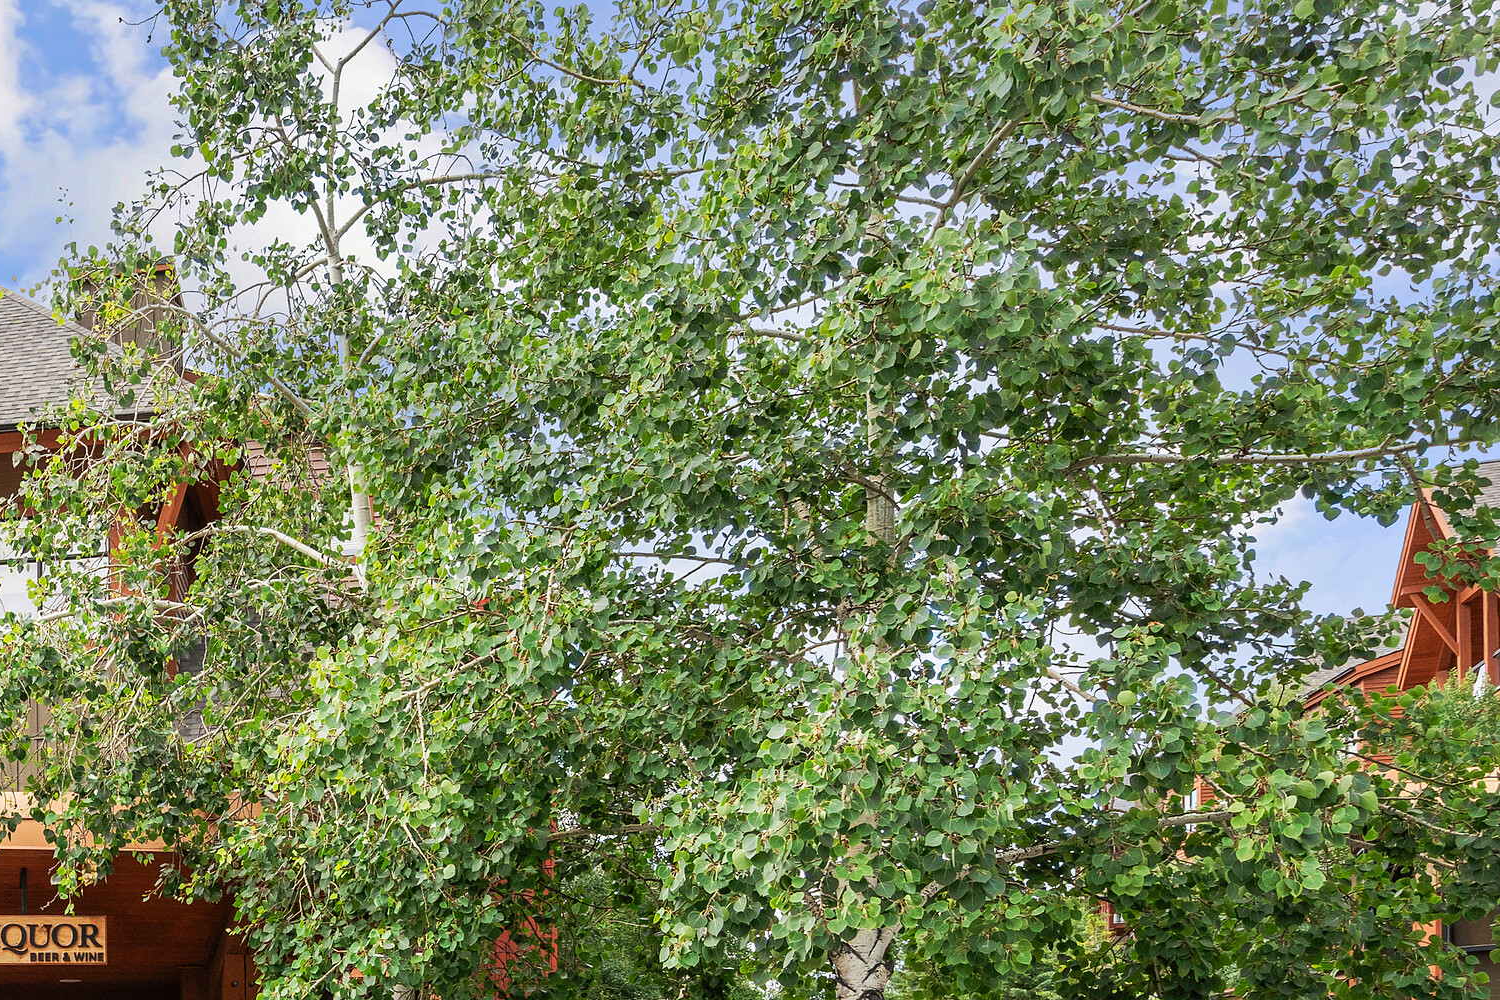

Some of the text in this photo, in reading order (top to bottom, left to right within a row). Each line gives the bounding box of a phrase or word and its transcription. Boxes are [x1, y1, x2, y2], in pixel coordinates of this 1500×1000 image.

[30, 952, 104, 962] BEER & WINE
